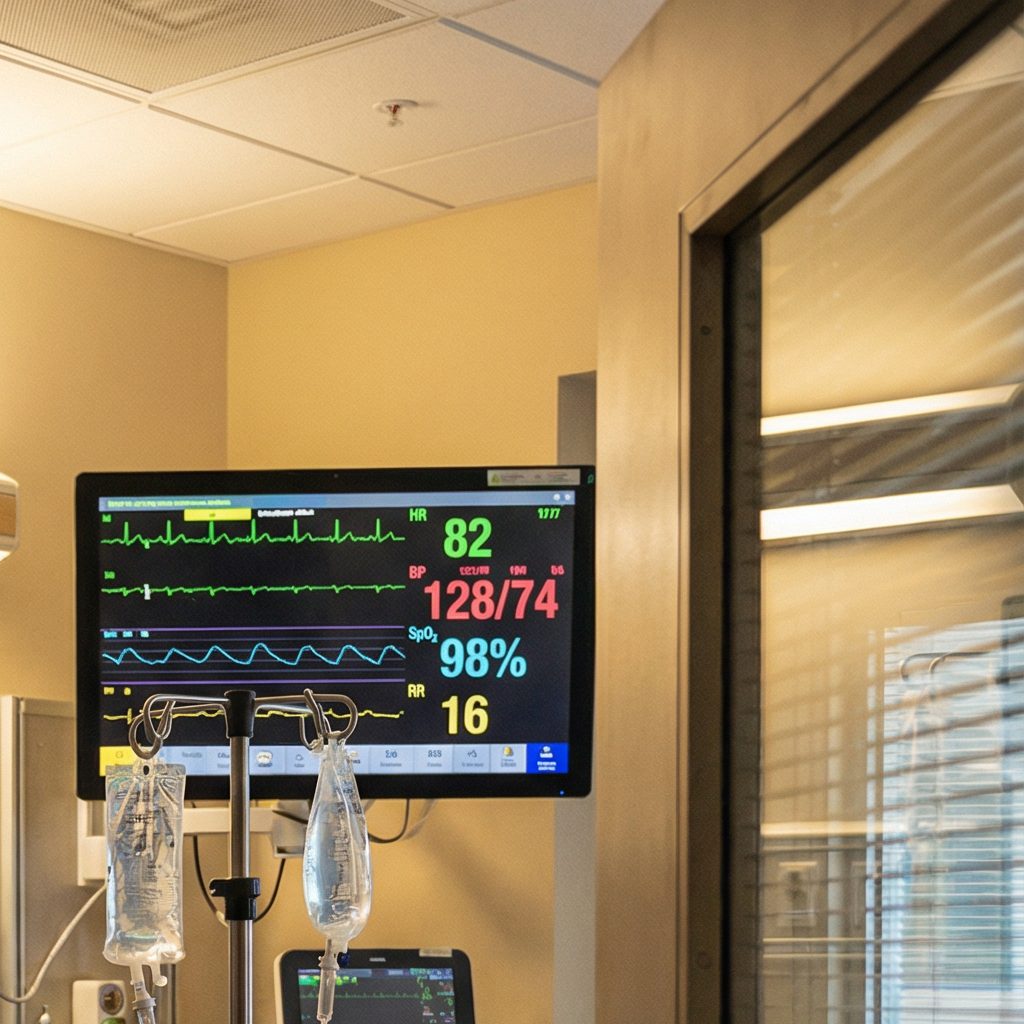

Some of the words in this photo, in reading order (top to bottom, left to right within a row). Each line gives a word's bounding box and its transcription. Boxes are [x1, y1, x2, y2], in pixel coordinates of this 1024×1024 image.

[409, 508, 427, 522] HR
[444, 517, 492, 558] 82
[409, 565, 427, 579] BP
[424, 579, 559, 620] 128/74
[440, 637, 527, 678] 98%
[407, 684, 426, 698] RR
[442, 695, 489, 734] 16
